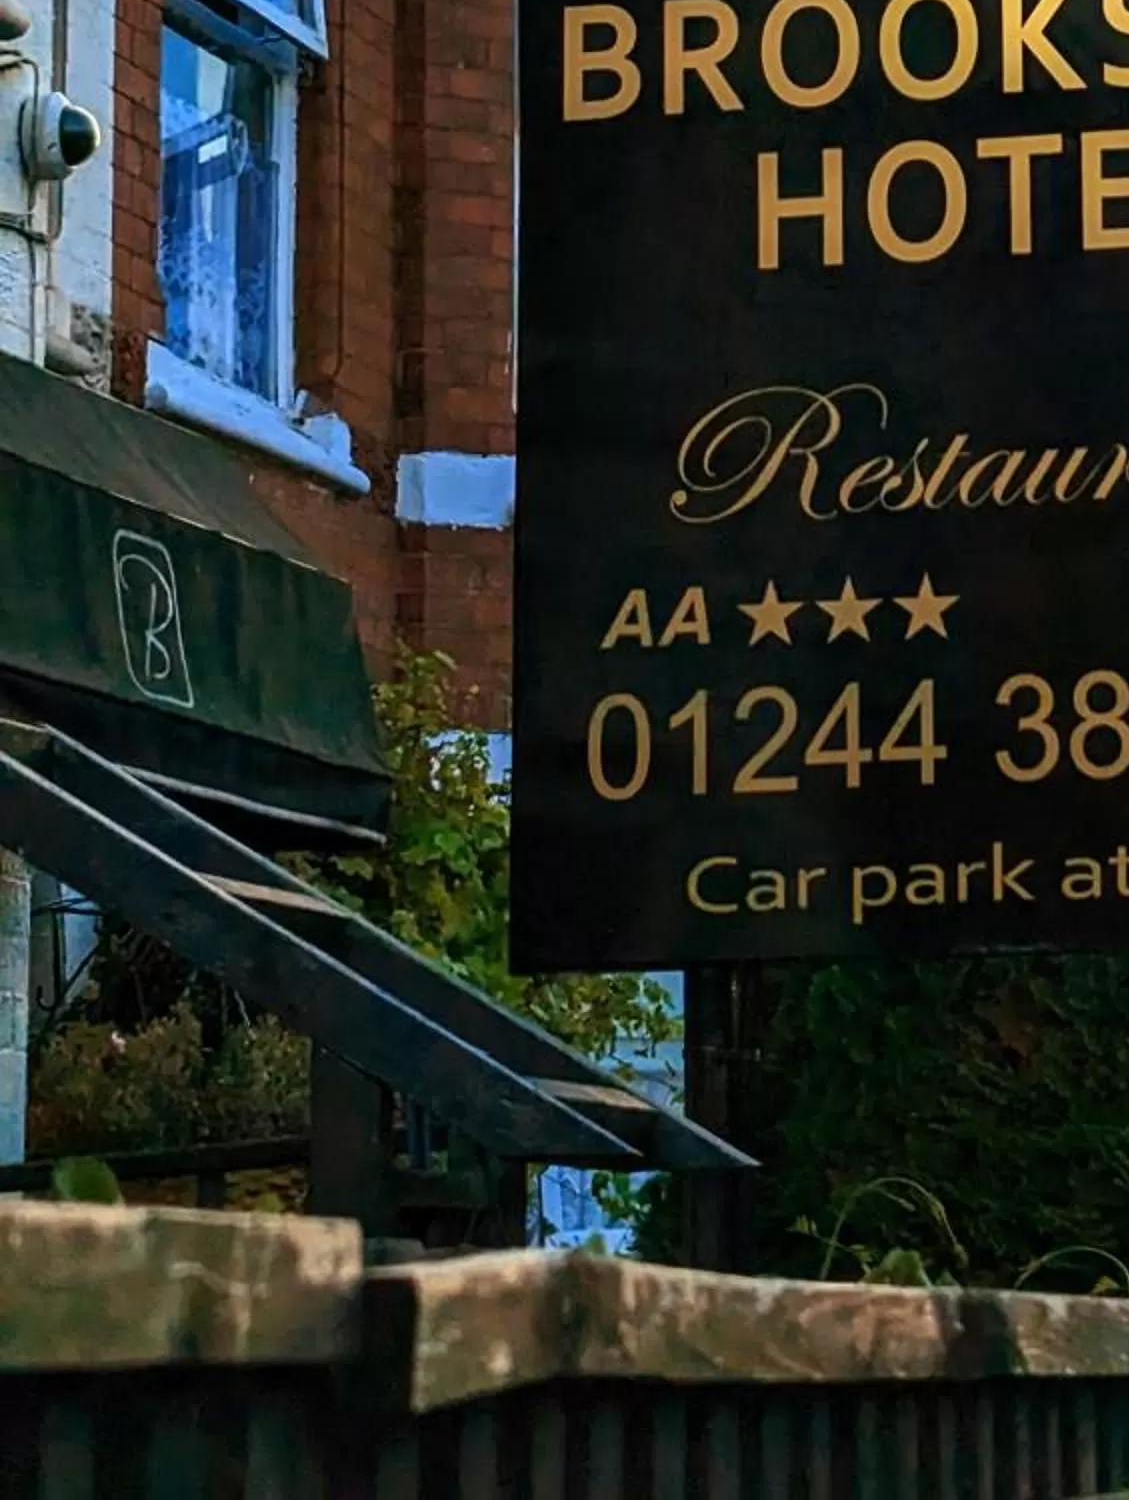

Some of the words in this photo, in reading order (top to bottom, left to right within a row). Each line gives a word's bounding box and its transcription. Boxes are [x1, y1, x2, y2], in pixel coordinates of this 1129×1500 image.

[119, 553, 174, 681] B
[601, 587, 712, 649] AA
[588, 680, 948, 801] 01244
[686, 857, 827, 913] Car
[850, 843, 1034, 924] park
